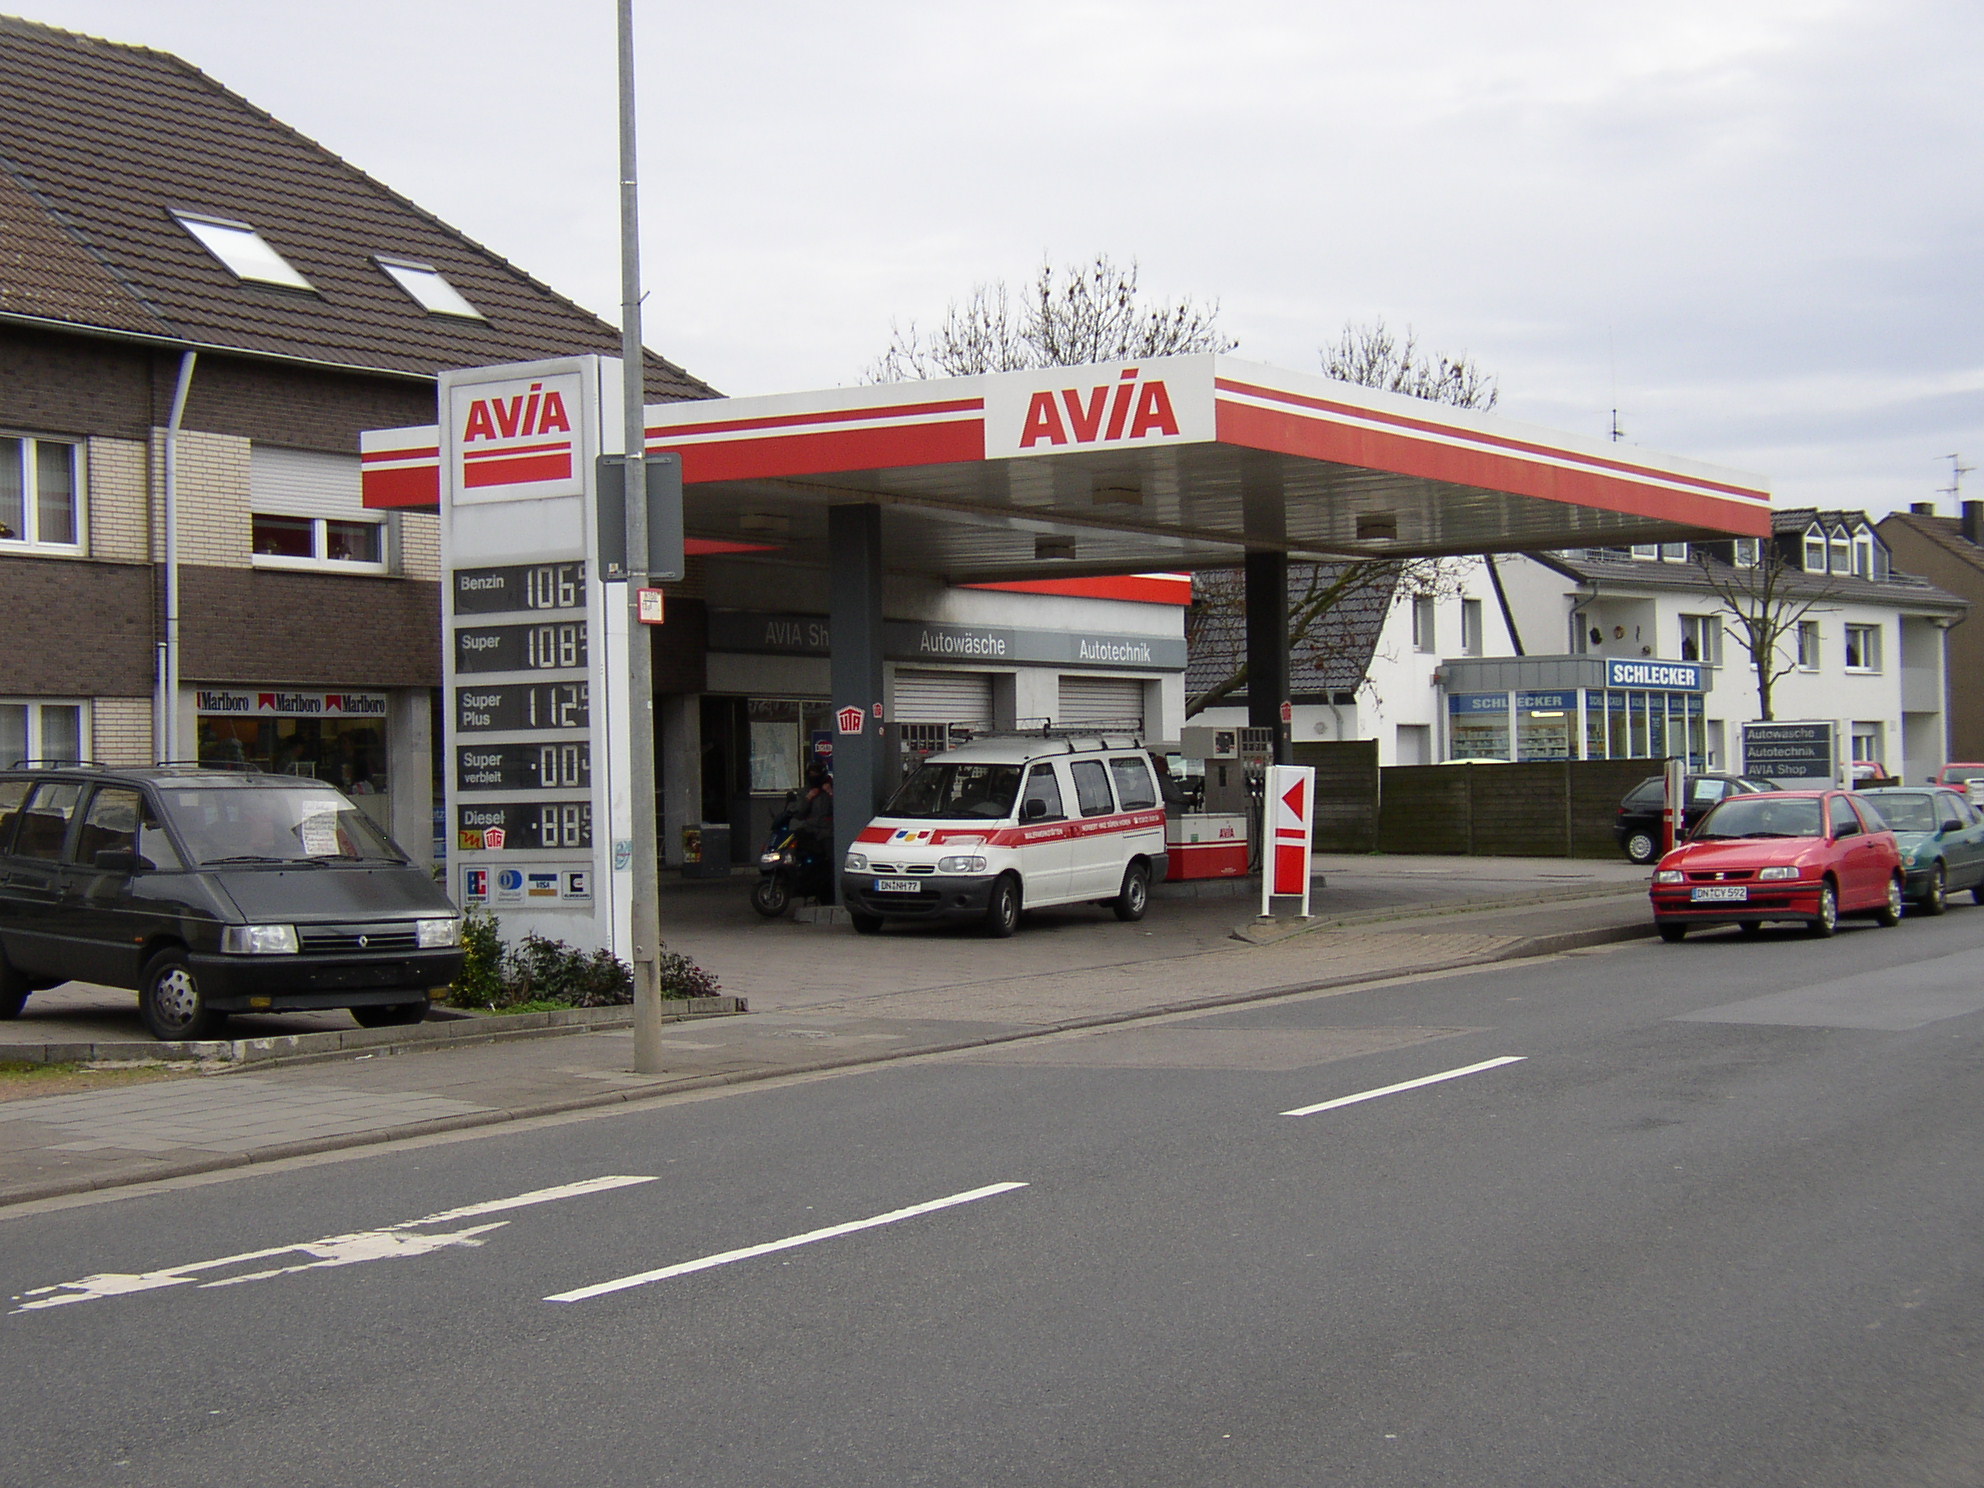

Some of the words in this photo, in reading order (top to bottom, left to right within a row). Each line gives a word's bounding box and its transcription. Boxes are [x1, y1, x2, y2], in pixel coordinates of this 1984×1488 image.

[464, 382, 571, 442] AVIA
[1019, 367, 1180, 448] AVIA
[460, 574, 504, 591] Benzin
[765, 621, 802, 645] AVIA
[462, 634, 501, 652] Super
[920, 630, 1006, 656] Autowäsche
[1080, 639, 1151, 663] Autotechnik
[1613, 664, 1696, 687] SCHLECKER
[202, 692, 249, 711] Marlboro
[276, 693, 321, 712] Marlboro
[343, 695, 385, 713] Marlboro
[462, 692, 502, 711] Super
[1471, 695, 1563, 710] SCHLECKER
[463, 711, 491, 726] Plus
[463, 751, 502, 771] Super
[1748, 764, 1774, 775] AVIA
[1777, 764, 1807, 776] Shop
[464, 770, 502, 784] verbleit
[464, 810, 505, 825] Diesel
